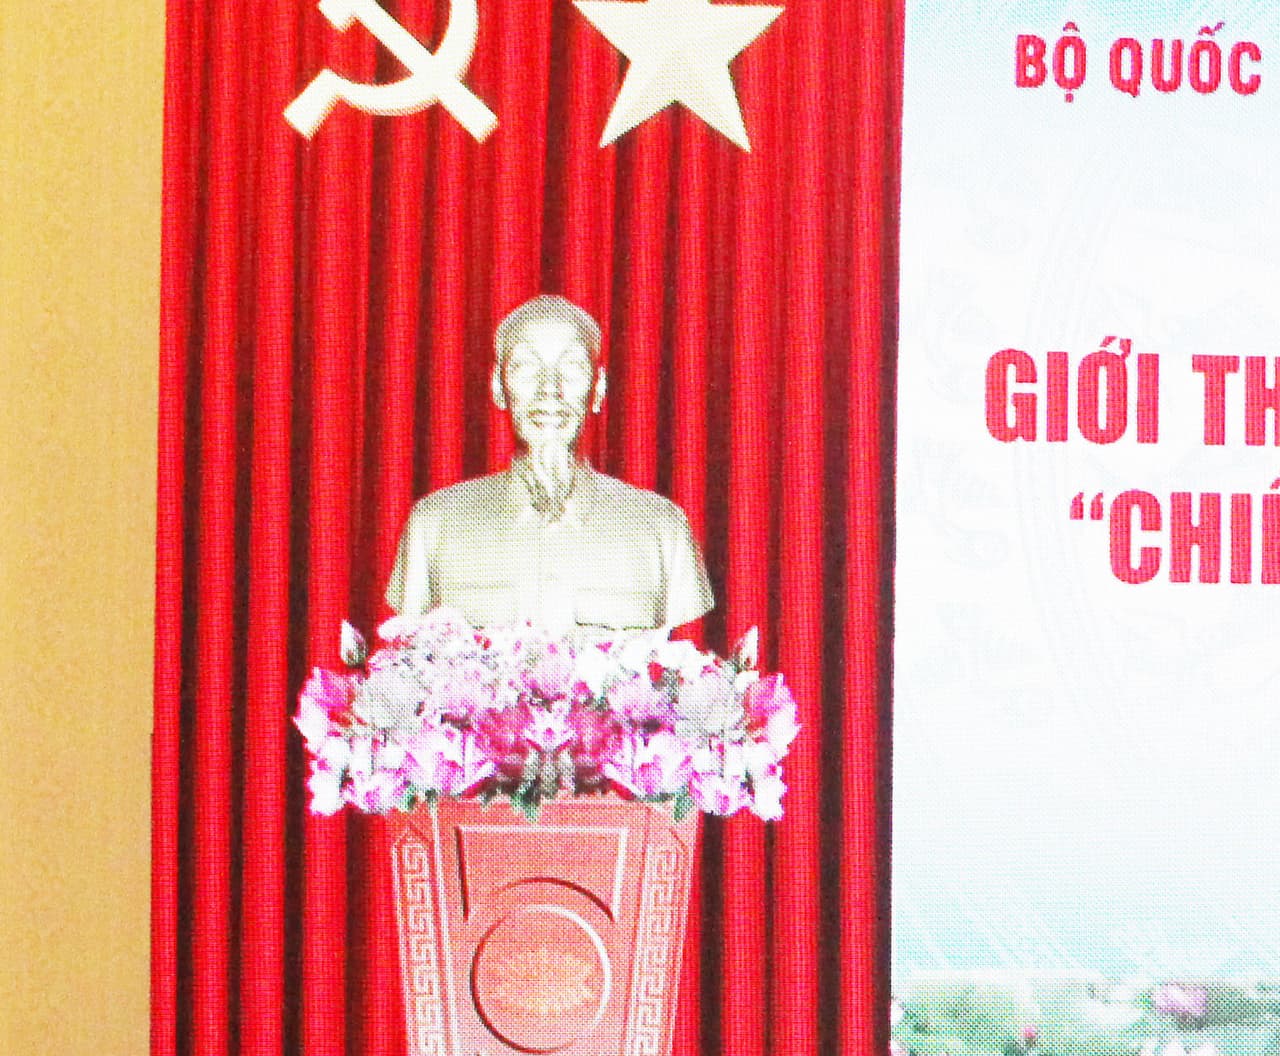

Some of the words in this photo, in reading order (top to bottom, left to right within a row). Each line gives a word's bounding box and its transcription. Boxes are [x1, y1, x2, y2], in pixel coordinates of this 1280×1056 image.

[1015, 22, 1087, 102] BỘ
[1109, 22, 1261, 96] QUỐC
[985, 336, 1159, 445] GIỚI
